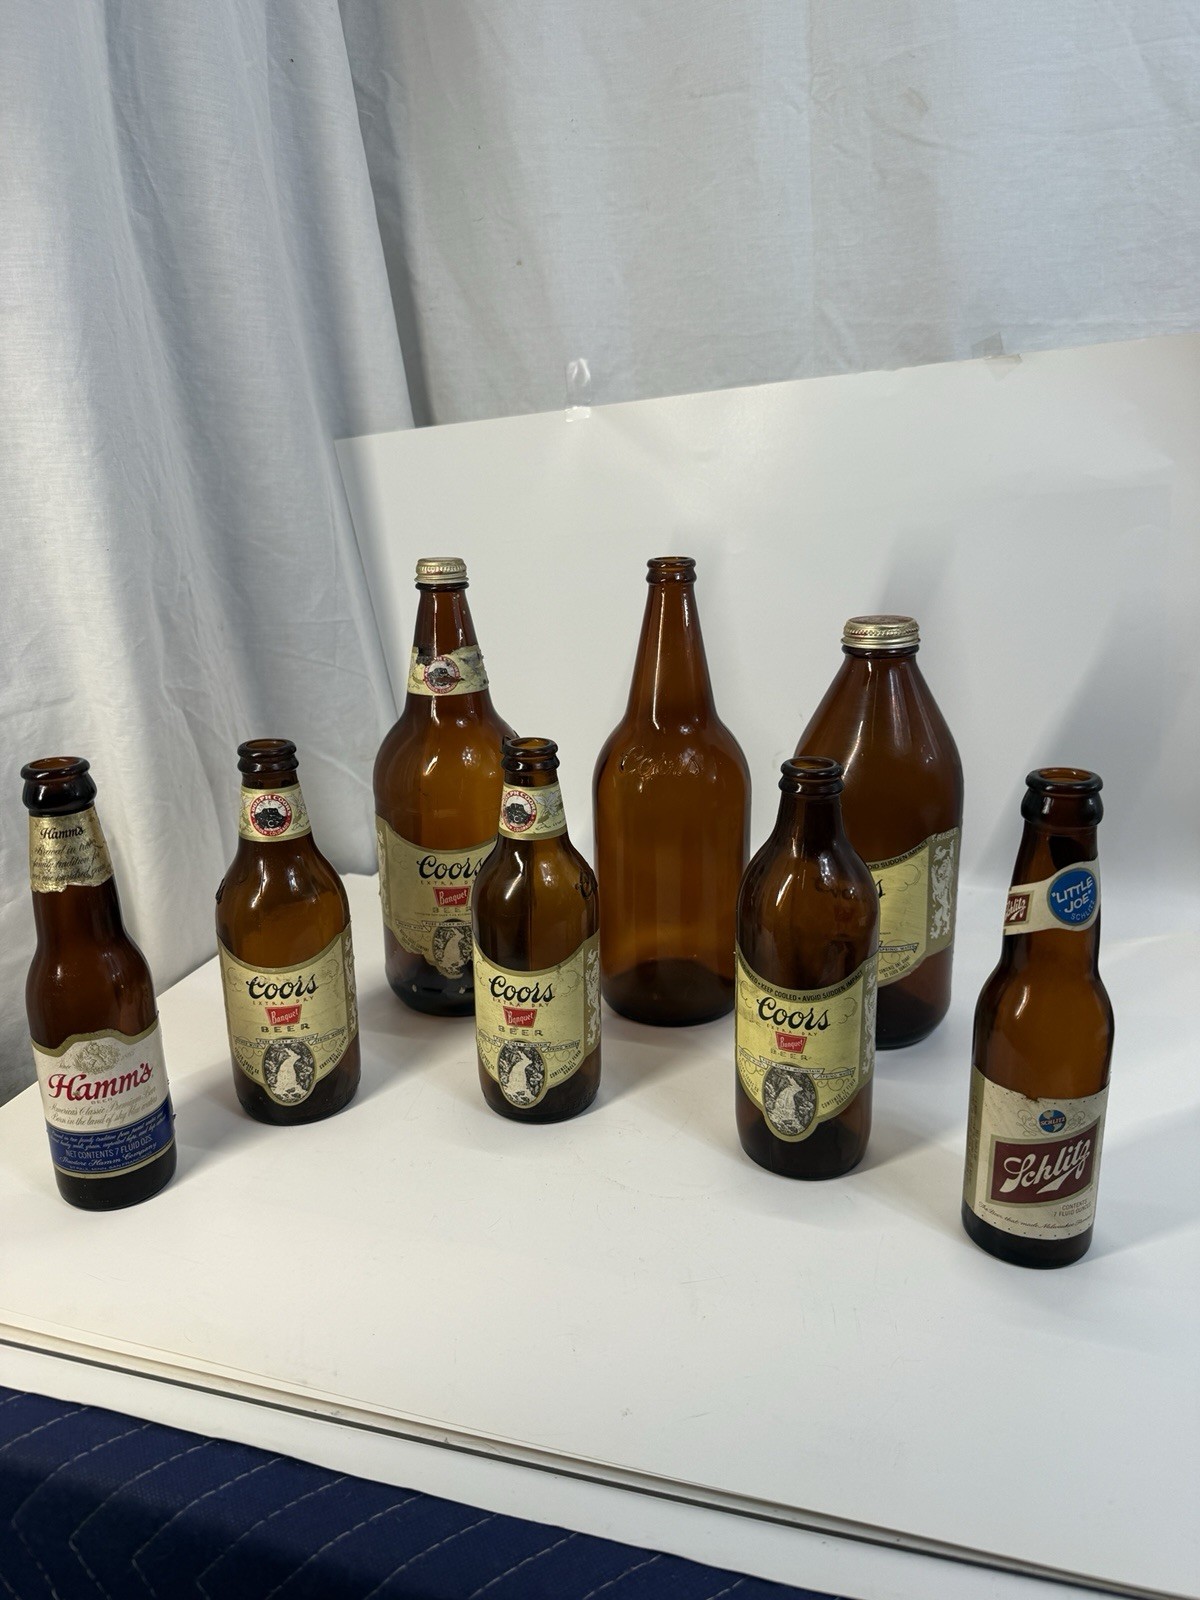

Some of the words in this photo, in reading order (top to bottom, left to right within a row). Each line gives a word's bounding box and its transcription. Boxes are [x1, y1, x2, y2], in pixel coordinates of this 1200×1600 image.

[881, 854, 907, 868] SUDDEN
[908, 840, 928, 857] IMPACT
[416, 855, 482, 879] Coors
[439, 889, 467, 905] Banquet
[433, 906, 471, 914] BEER
[246, 974, 319, 999] Coors
[489, 976, 556, 1003] Coors
[761, 983, 773, 993] KEEP
[774, 990, 797, 1001] COOLED
[802, 994, 821, 1002] AVOID
[823, 984, 845, 999] SUDDEN
[846, 970, 863, 988] IMPACT
[296, 996, 314, 1004] DRY
[493, 997, 521, 1007] EXTRA
[271, 1008, 299, 1024] Banquet
[506, 1009, 533, 1024] Banquet
[756, 997, 831, 1030] Coors
[261, 1023, 310, 1033] BEER
[498, 1025, 543, 1036] BEER
[767, 1023, 791, 1033] EXTRA
[780, 1037, 803, 1049] Banquet
[771, 1048, 808, 1060] BEER
[48, 1062, 153, 1101] Hamm's
[67, 1117, 74, 1125] in
[76, 1117, 84, 1125] the
[87, 1114, 105, 1126] land
[105, 1112, 114, 1128] of
[1040, 1116, 1066, 1126] SCHLITZ
[65, 1149, 77, 1157] NET
[78, 1149, 113, 1159] CONTENTS
[115, 1147, 119, 1156] 7
[121, 1140, 140, 1154] FLUID
[88, 1158, 120, 1168] Hamm
[122, 1142, 157, 1160] Company
[999, 1139, 1091, 1195] Schlitz
[1061, 1199, 1088, 1211] CONTENTS
[1004, 1216, 1019, 1224] that
[1059, 1209, 1074, 1217] FLUID
